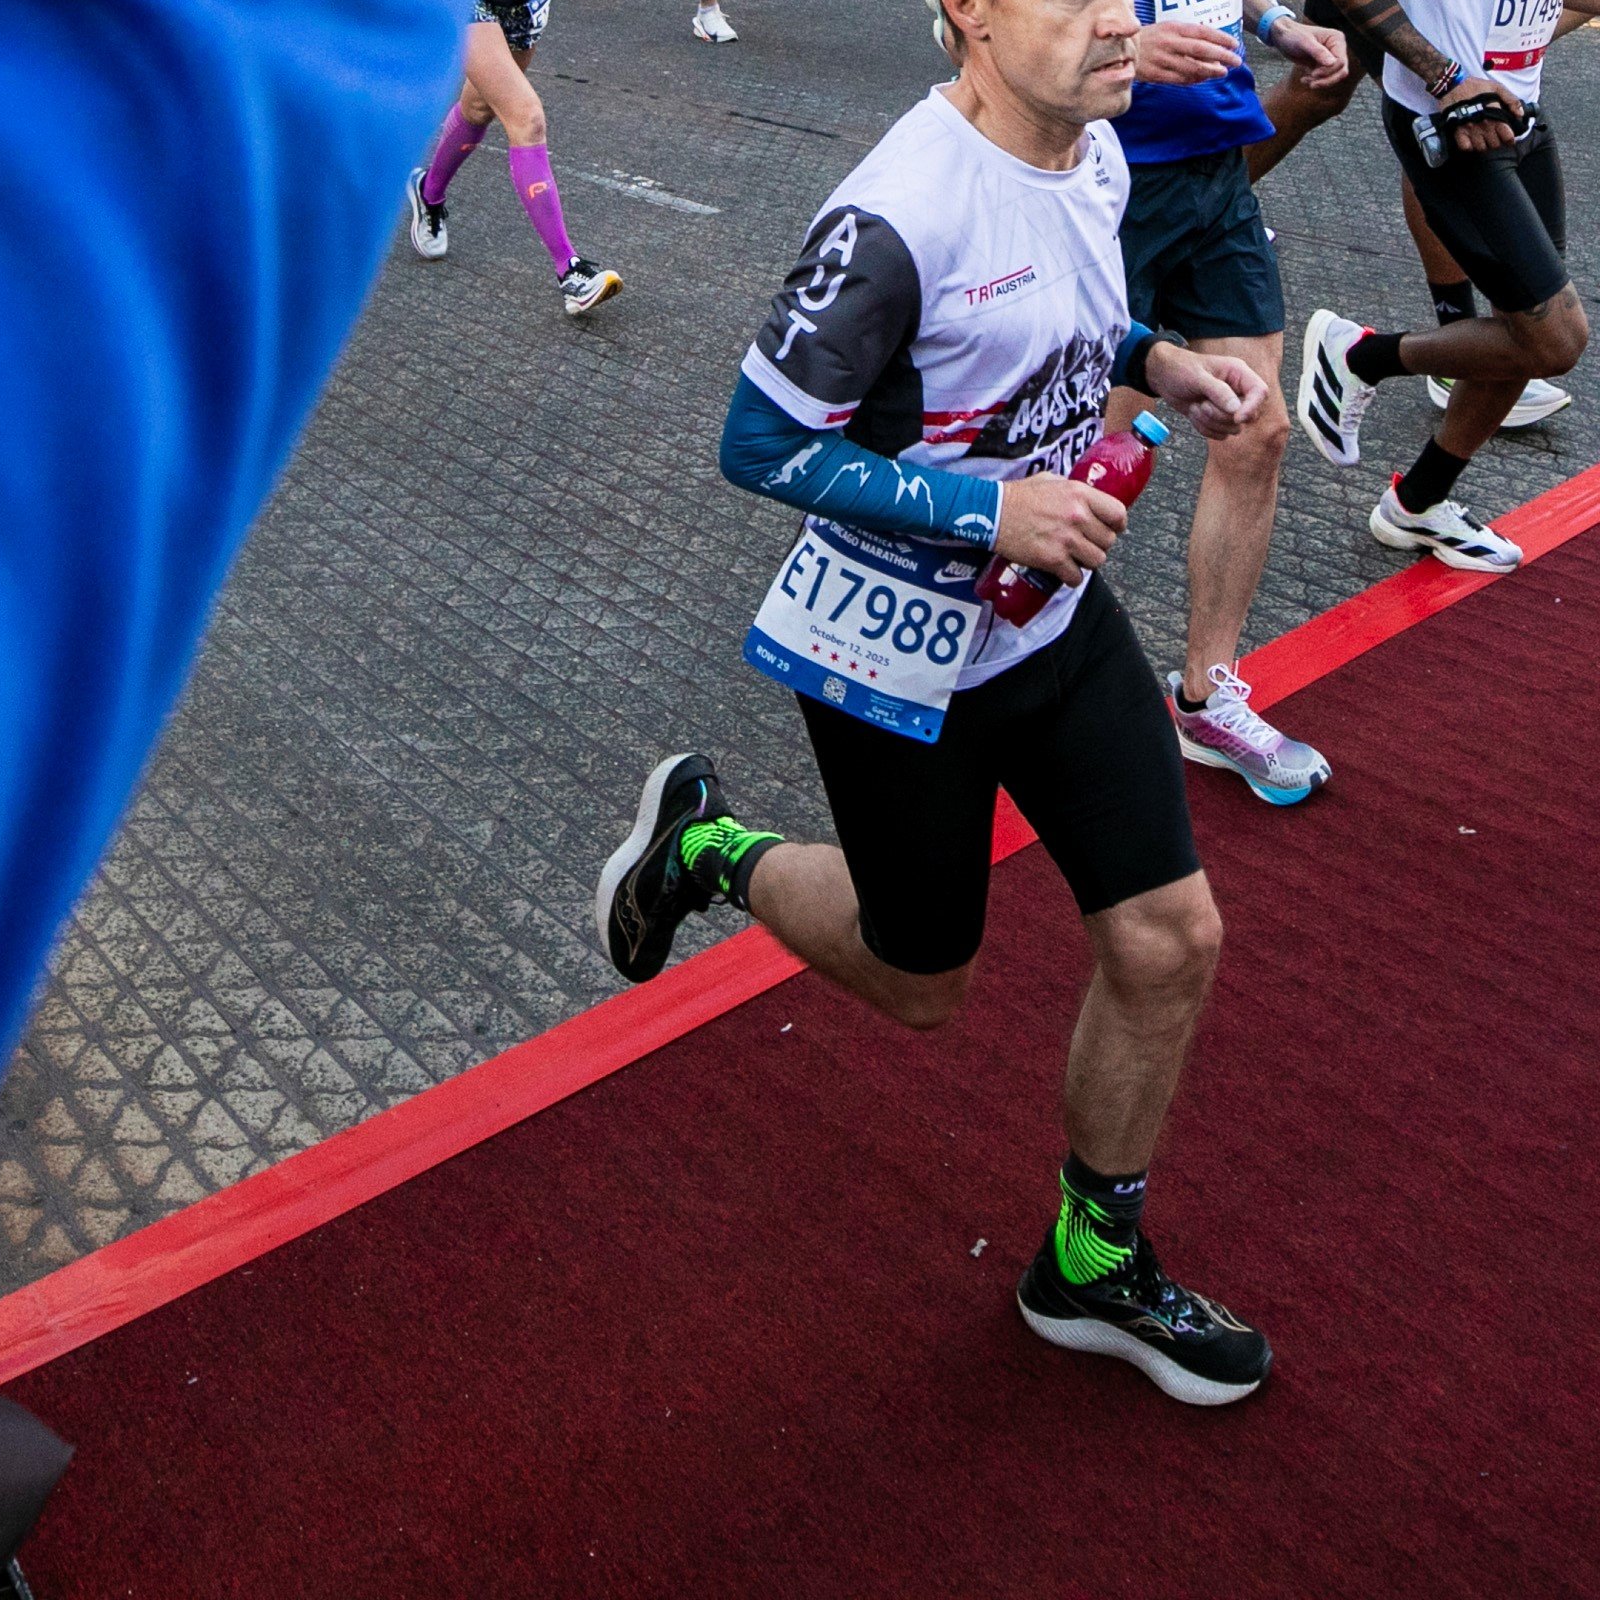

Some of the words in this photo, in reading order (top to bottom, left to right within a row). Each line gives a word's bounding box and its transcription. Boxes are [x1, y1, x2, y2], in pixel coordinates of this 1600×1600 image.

[775, 213, 858, 360] AUT
[995, 271, 1037, 297] AUSTRIA
[829, 520, 859, 548] CHICAGO
[860, 540, 918, 573] MARATHON
[856, 527, 893, 549] AMERICA
[946, 560, 977, 578] RUN
[781, 541, 967, 666] E17988
[756, 645, 778, 665] ROW
[777, 657, 790, 672] 29
[809, 624, 847, 648] October
[849, 642, 863, 657] 12,
[865, 649, 890, 667] 2025
[912, 716, 920, 727] 4
